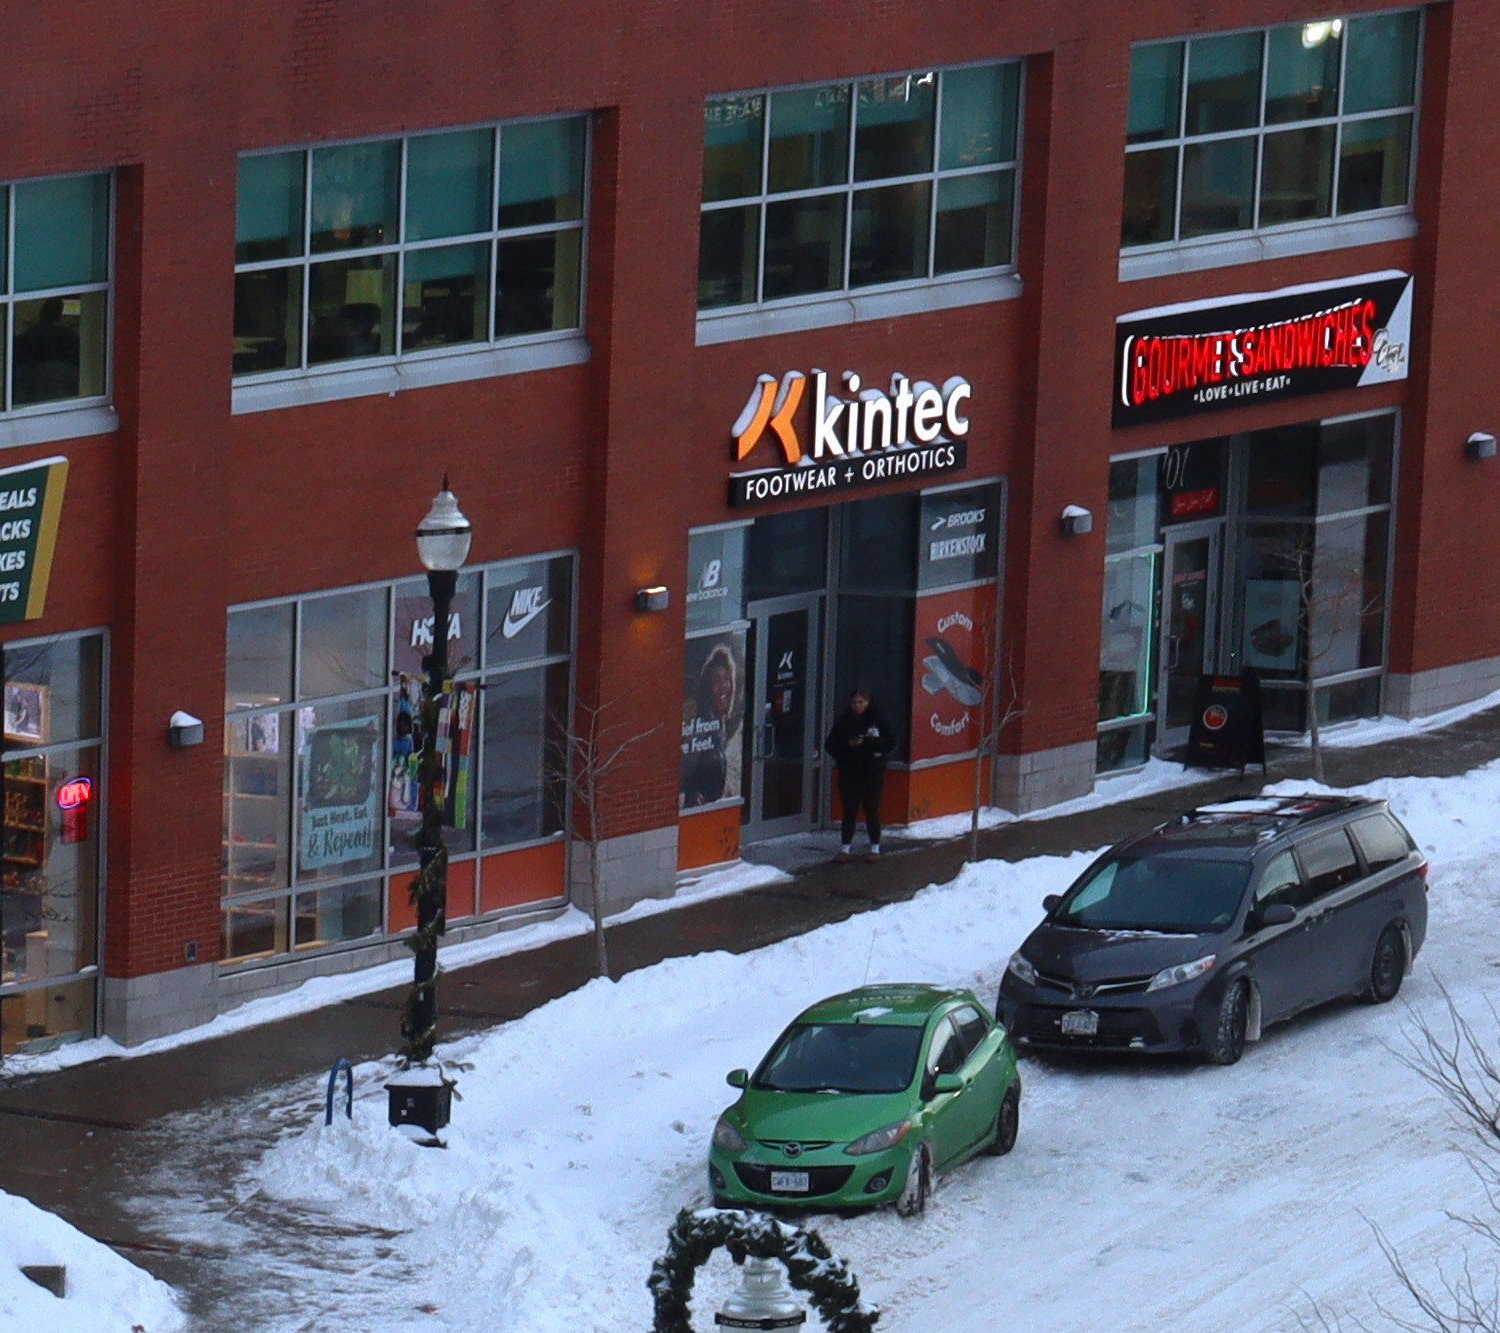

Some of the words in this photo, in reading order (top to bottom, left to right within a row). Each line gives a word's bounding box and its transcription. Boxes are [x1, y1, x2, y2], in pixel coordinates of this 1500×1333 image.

[1241, 300, 1376, 377] SANDWICHES
[1199, 385, 1228, 402] LOVE
[1234, 380, 1260, 397] LIVE
[1264, 376, 1286, 392] EAT
[814, 372, 971, 459] kintec
[746, 466, 837, 500] FOOTWEAR
[862, 446, 956, 480] ORTHOTICS
[947, 508, 986, 528] BROOKS
[930, 533, 986, 561] BIRKENSTOCK
[512, 587, 542, 616] NIKE
[937, 611, 973, 632] Custom
[699, 718, 720, 734] from
[930, 711, 970, 736] Comfort
[60, 783, 89, 804] OPEN
[312, 812, 329, 830] Just
[354, 807, 368, 821] Eat
[308, 839, 321, 859] &
